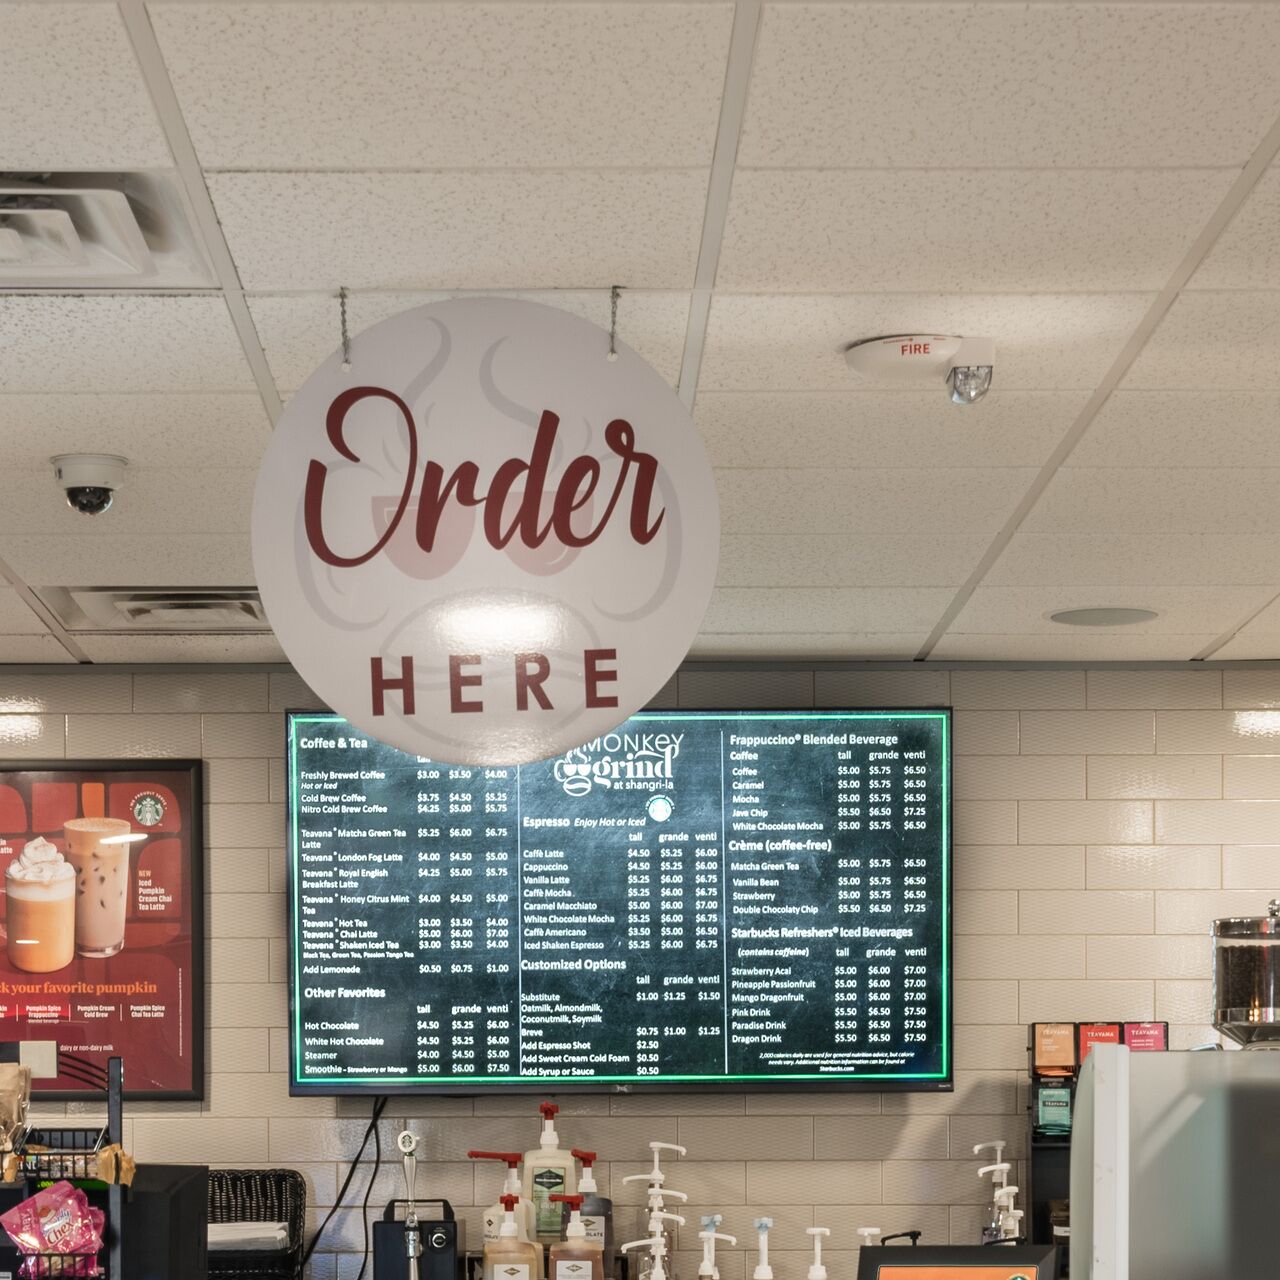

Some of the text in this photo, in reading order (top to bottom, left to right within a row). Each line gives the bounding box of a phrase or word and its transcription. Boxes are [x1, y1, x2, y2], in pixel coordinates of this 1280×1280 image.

[900, 343, 930, 356] FIRE
[303, 385, 666, 568] Order
[370, 648, 619, 716] HERE
[300, 737, 368, 749] Coffee & Tea
[803, 734, 847, 745] Blended
[849, 734, 898, 746] Beverage
[730, 750, 926, 761] Coffee tall grande venti
[592, 744, 680, 789] grind
[301, 770, 507, 780] Freshly Brewed Coffee $3.00 $3.50 $4.00
[613, 781, 674, 792] at shangri-la
[523, 817, 570, 829] Espresso
[574, 817, 598, 827] Enjoy
[599, 817, 615, 826] Hot
[627, 817, 646, 826] Iced
[629, 832, 717, 843] tall grande venti
[728, 839, 832, 852] Crème (coffee-free)
[523, 848, 718, 858] Caffè Latte $4.50 $5.25 $6.00
[523, 861, 718, 872] Cappuccino $4.50 $5.25 $6.00
[138, 887, 165, 895] Pumpkin
[523, 901, 718, 911] Caramel Macchiato $5.00 $6.00 $7.00
[731, 927, 780, 939] Starbucks
[840, 927, 861, 937] Iced
[863, 927, 913, 939] Beverages
[521, 959, 626, 972] Customized Options
[11, 984, 41, 996] your
[43, 981, 94, 994] favorite
[96, 982, 157, 996] pumpkin
[304, 986, 386, 998] Other Favorites
[732, 1008, 771, 1017] Pink Drink
[47, 1219, 75, 1244] Chex
